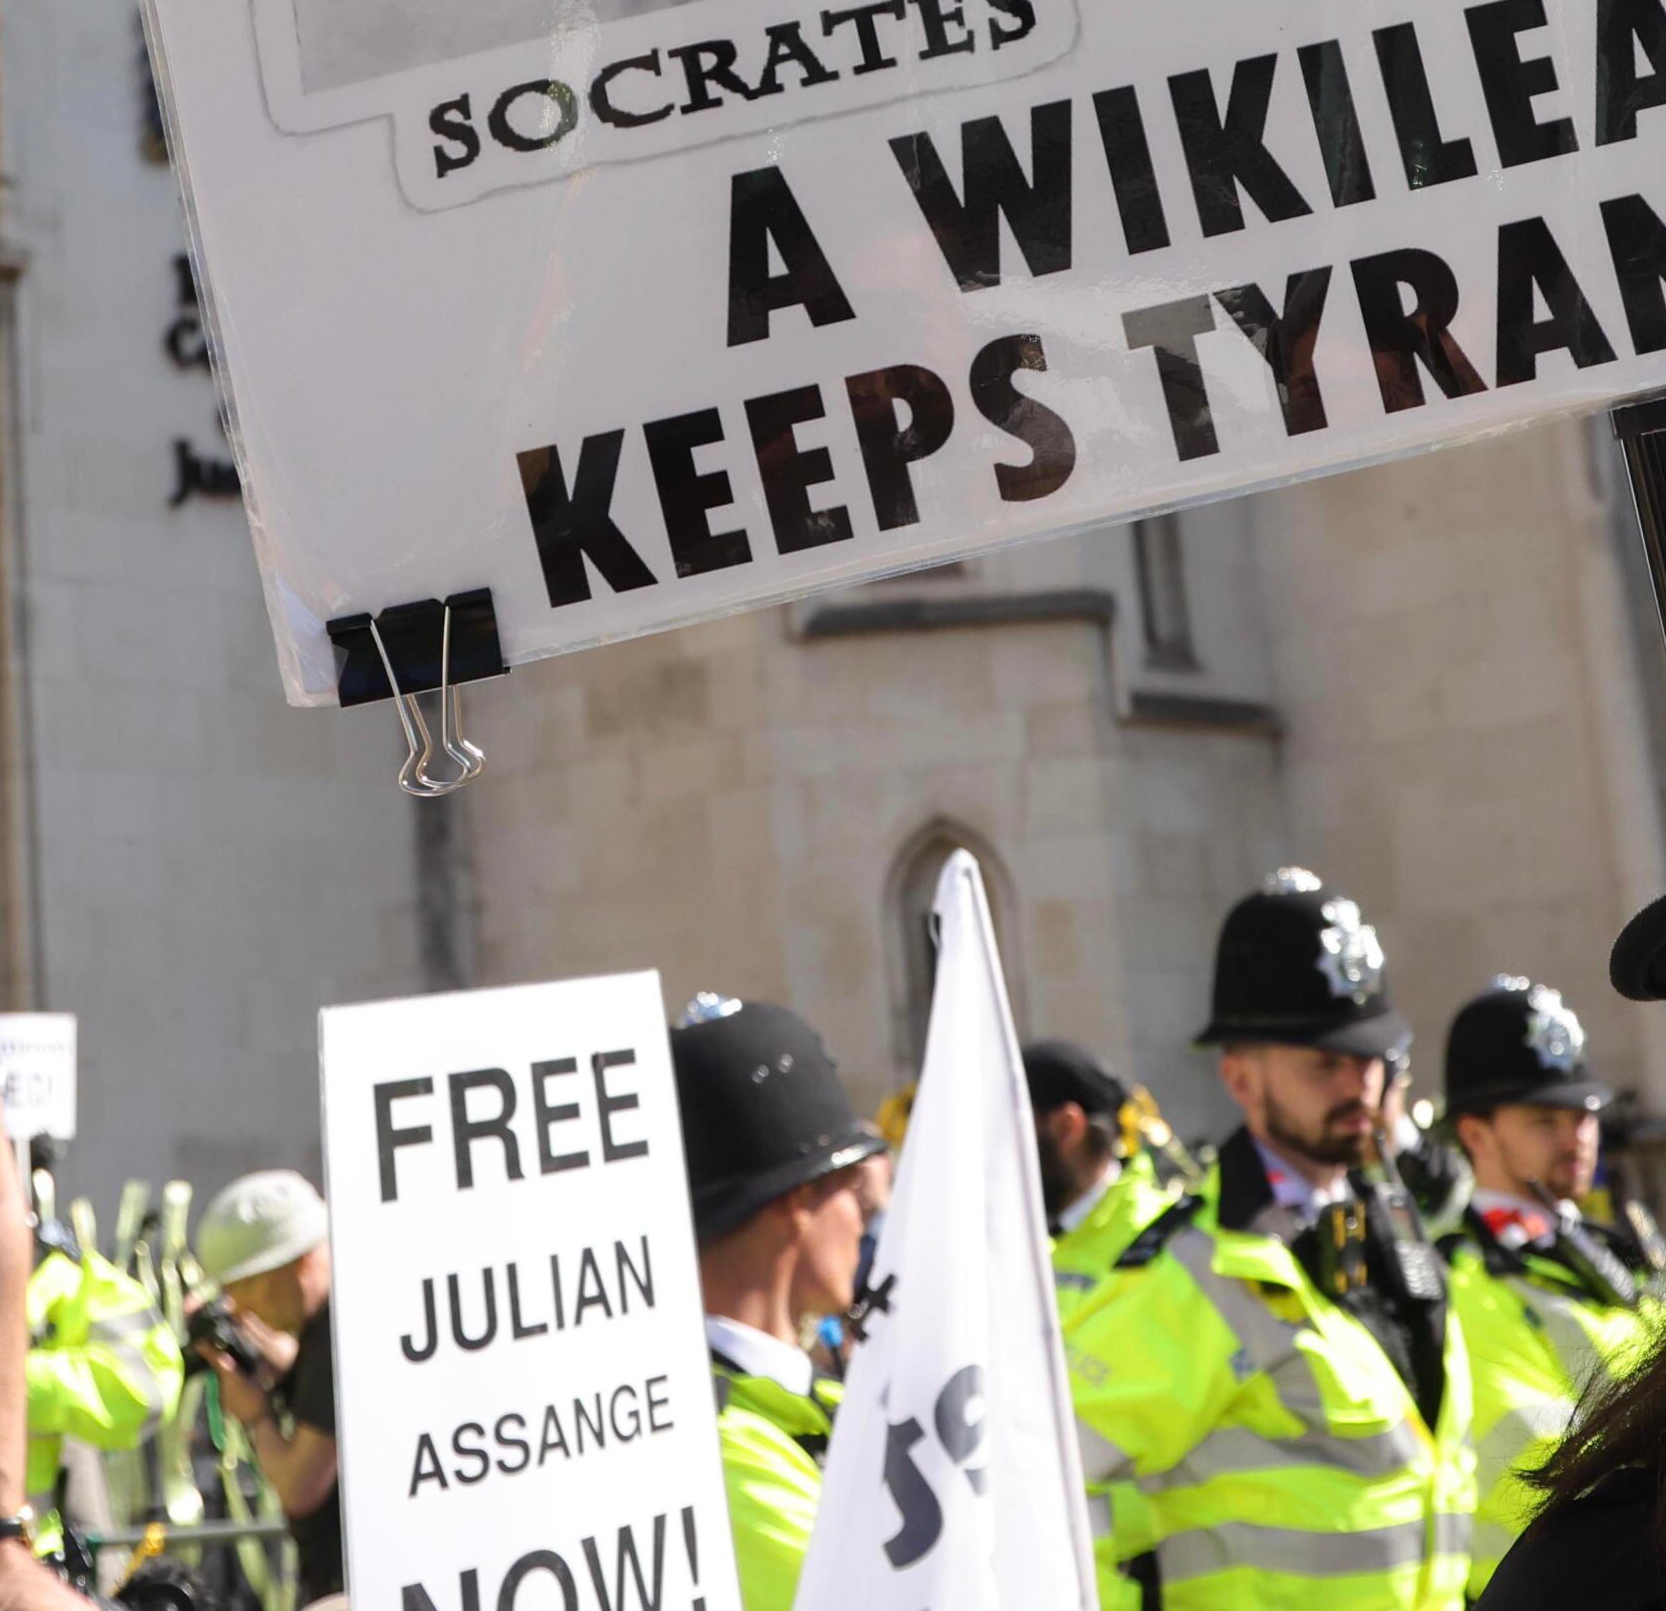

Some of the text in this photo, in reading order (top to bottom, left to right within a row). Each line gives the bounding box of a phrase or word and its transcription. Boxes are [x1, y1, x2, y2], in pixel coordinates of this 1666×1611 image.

[725, 165, 859, 349] A
[516, 332, 1077, 610] KEEPS
[372, 1048, 651, 1203] FREE
[400, 1235, 657, 1364] JULIAN
[408, 1374, 676, 1497] ASSANGE
